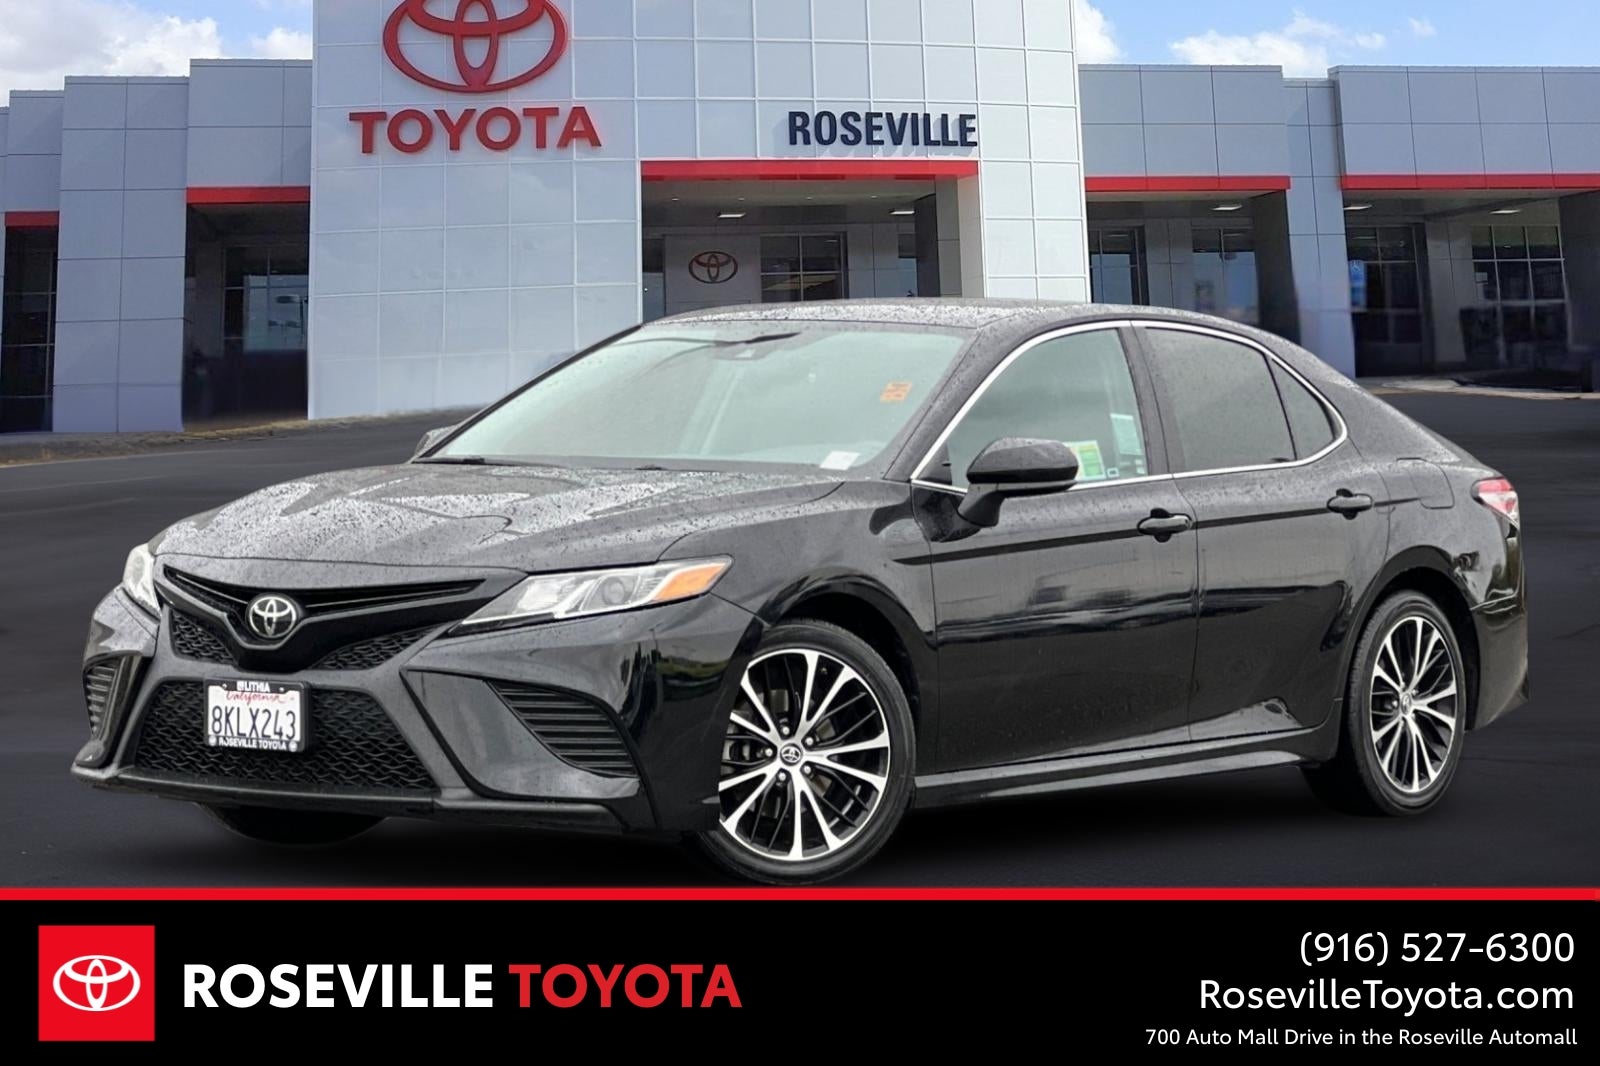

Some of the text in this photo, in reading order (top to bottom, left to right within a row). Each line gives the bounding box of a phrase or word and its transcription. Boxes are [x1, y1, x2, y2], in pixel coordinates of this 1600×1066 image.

[349, 106, 602, 154] TOYOTA
[788, 111, 978, 147] ROSEVILLE
[226, 691, 286, 706] California
[212, 705, 296, 740] 8KLX243
[218, 737, 287, 751] ROSEVILLE TOYOTA
